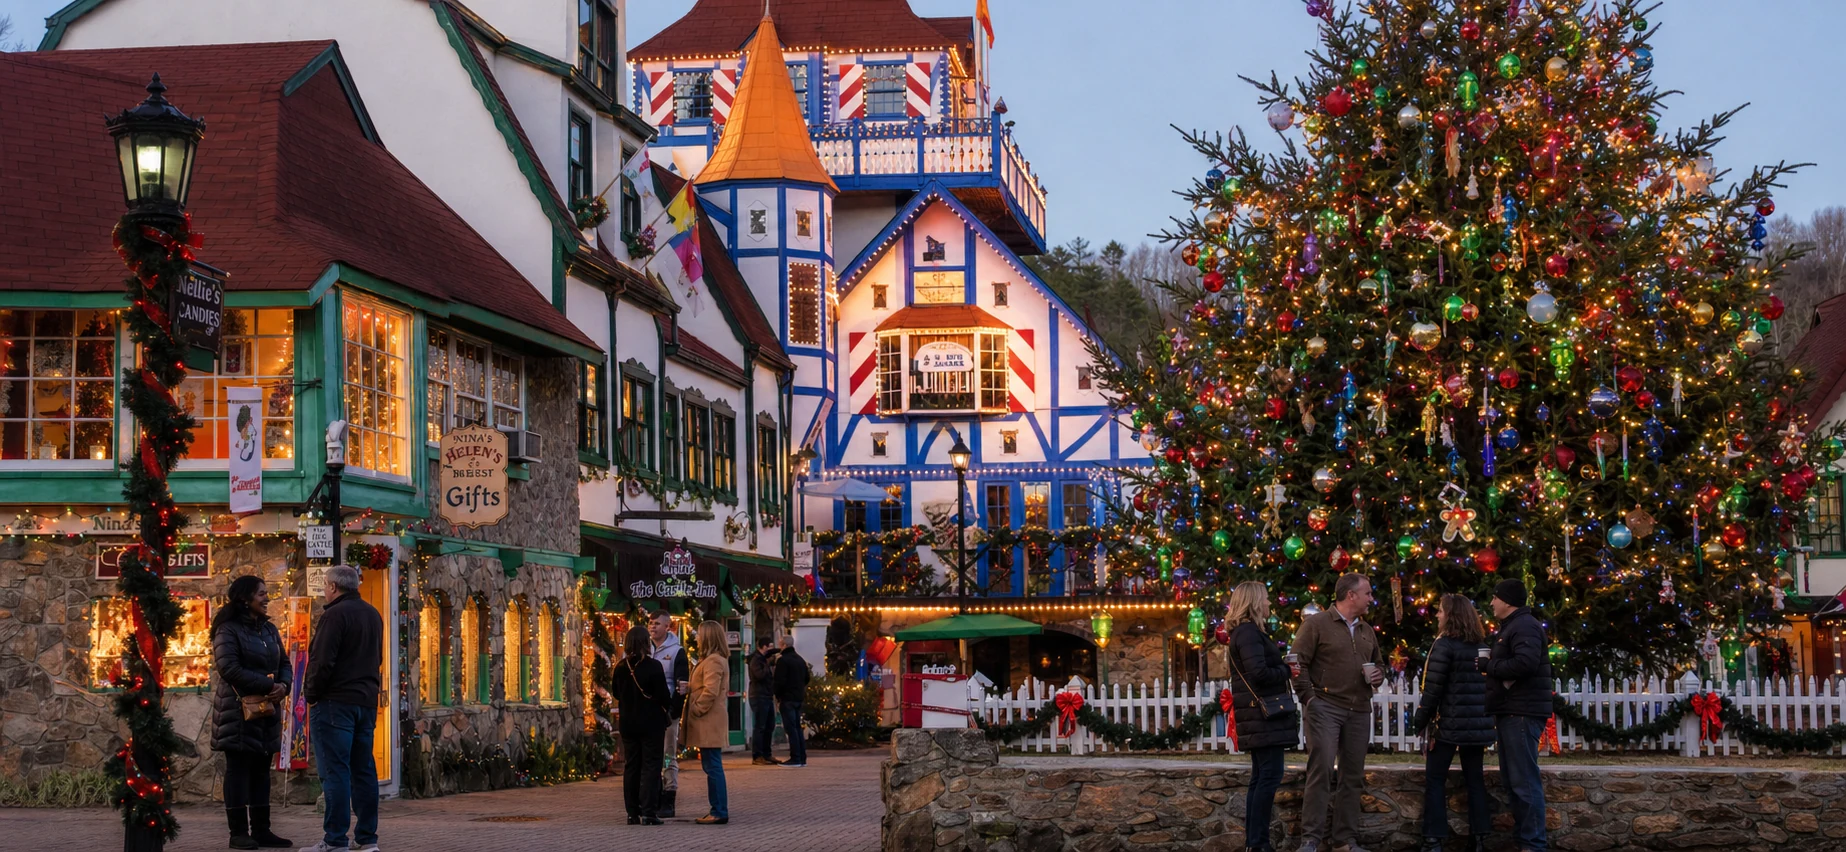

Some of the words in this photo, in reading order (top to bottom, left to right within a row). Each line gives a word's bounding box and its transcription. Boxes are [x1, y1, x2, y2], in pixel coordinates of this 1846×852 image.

[177, 275, 221, 305] Nellie's
[179, 301, 221, 328] CANDIES
[453, 433, 493, 444] NINA'S
[445, 446, 503, 464] HELEN'S
[446, 484, 500, 513] Gifts
[93, 515, 141, 530] Nina's
[168, 553, 206, 567] GIFTS
[629, 581, 654, 598] The
[694, 580, 718, 598] Inn
